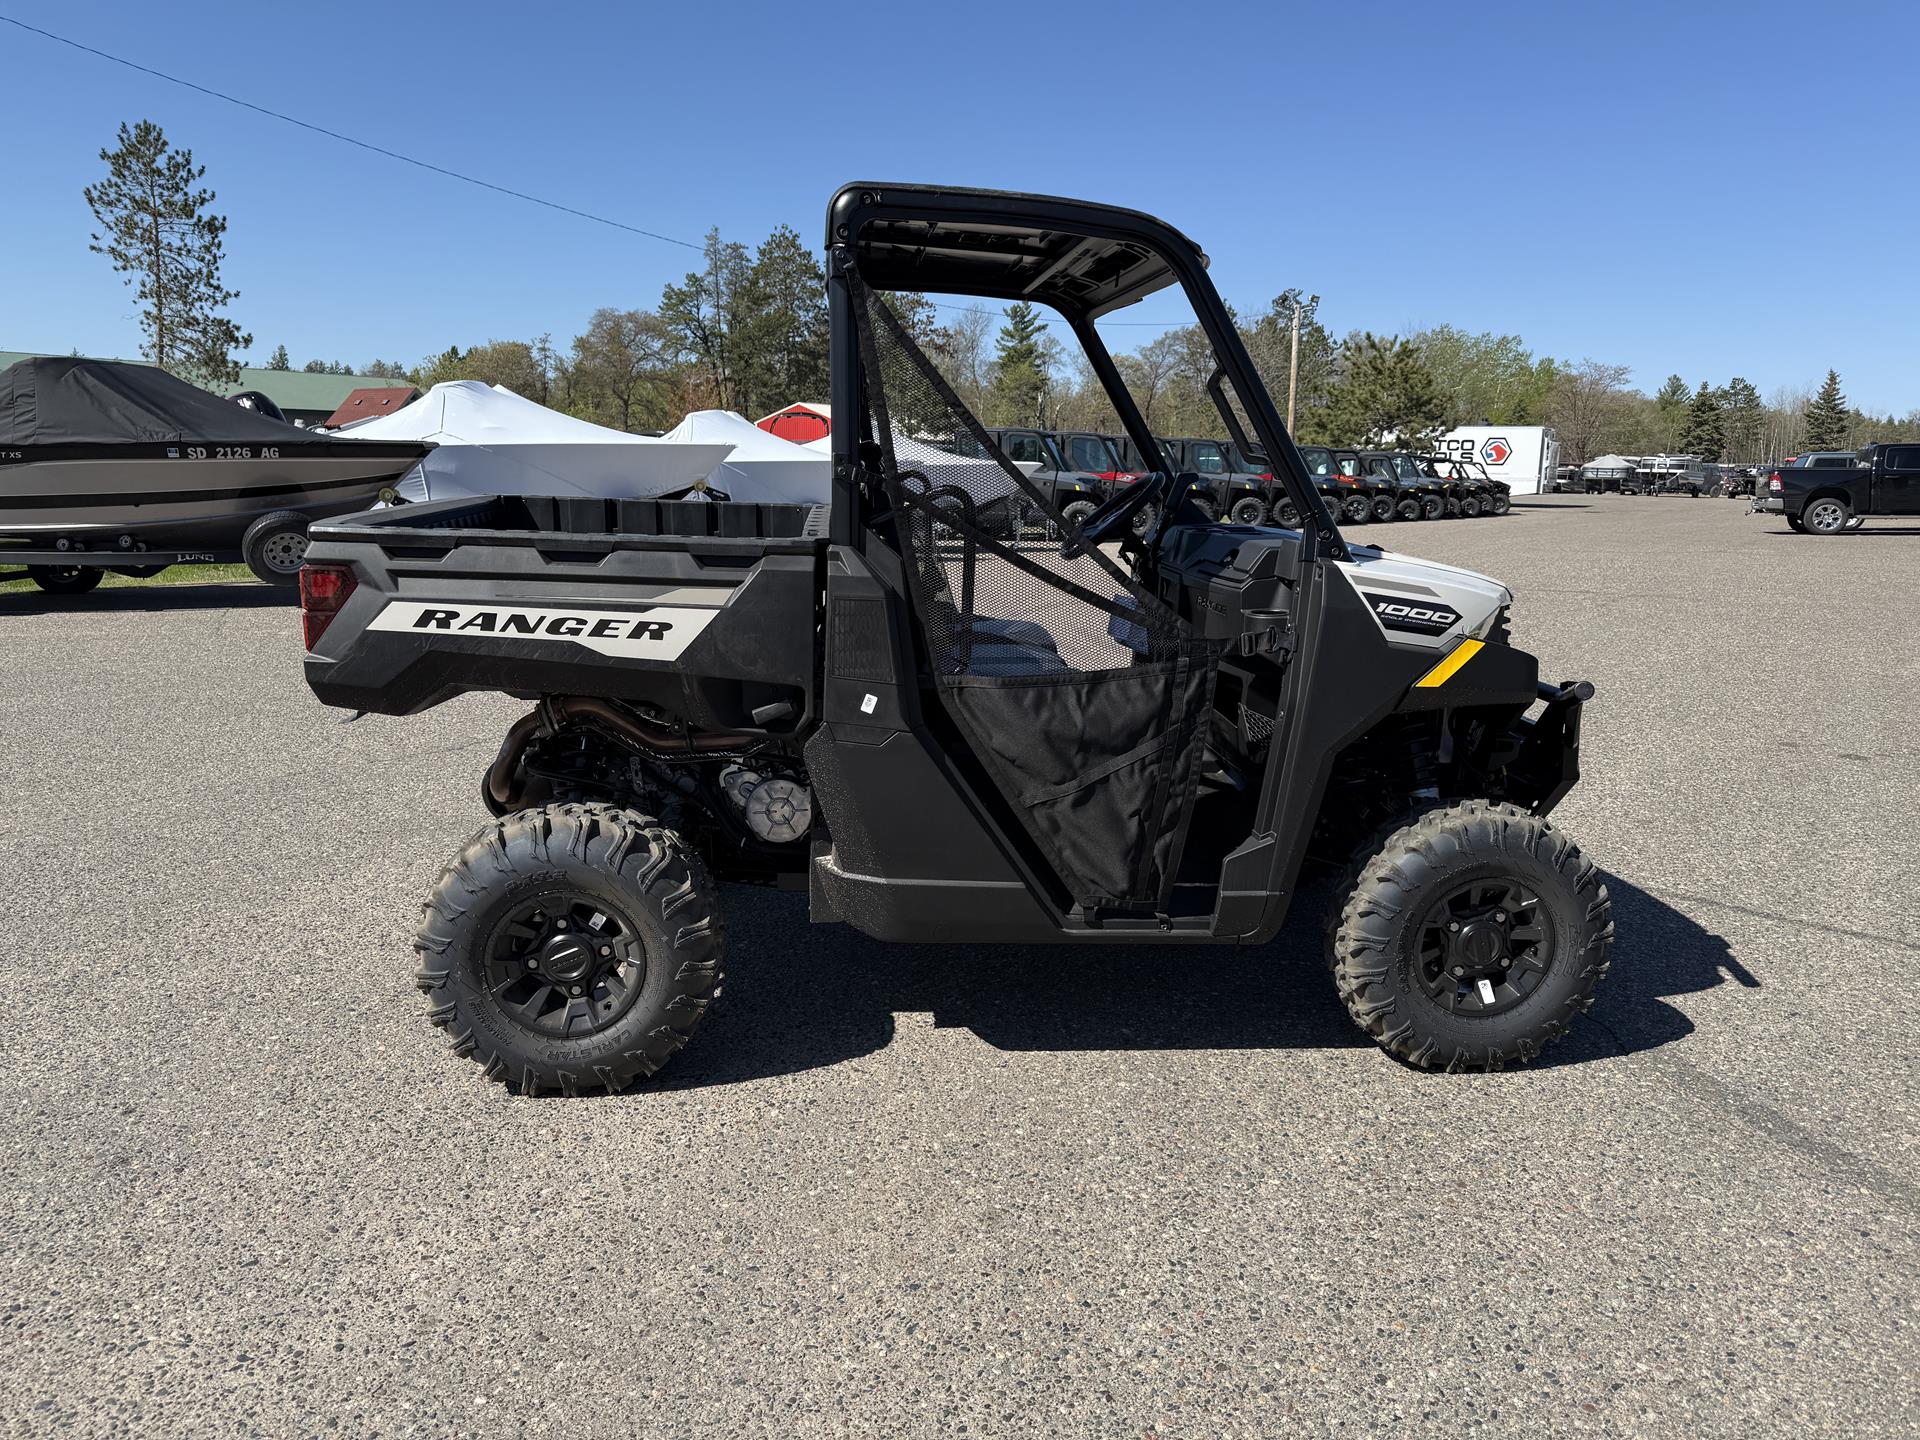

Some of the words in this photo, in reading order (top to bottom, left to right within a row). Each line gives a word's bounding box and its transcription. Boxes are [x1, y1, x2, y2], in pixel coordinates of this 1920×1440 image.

[9, 451, 22, 459] XS
[187, 447, 207, 459] SD
[216, 447, 251, 459] 2126
[261, 447, 280, 459] AG
[1375, 603, 1456, 623] 1000
[412, 609, 673, 640] RANGER
